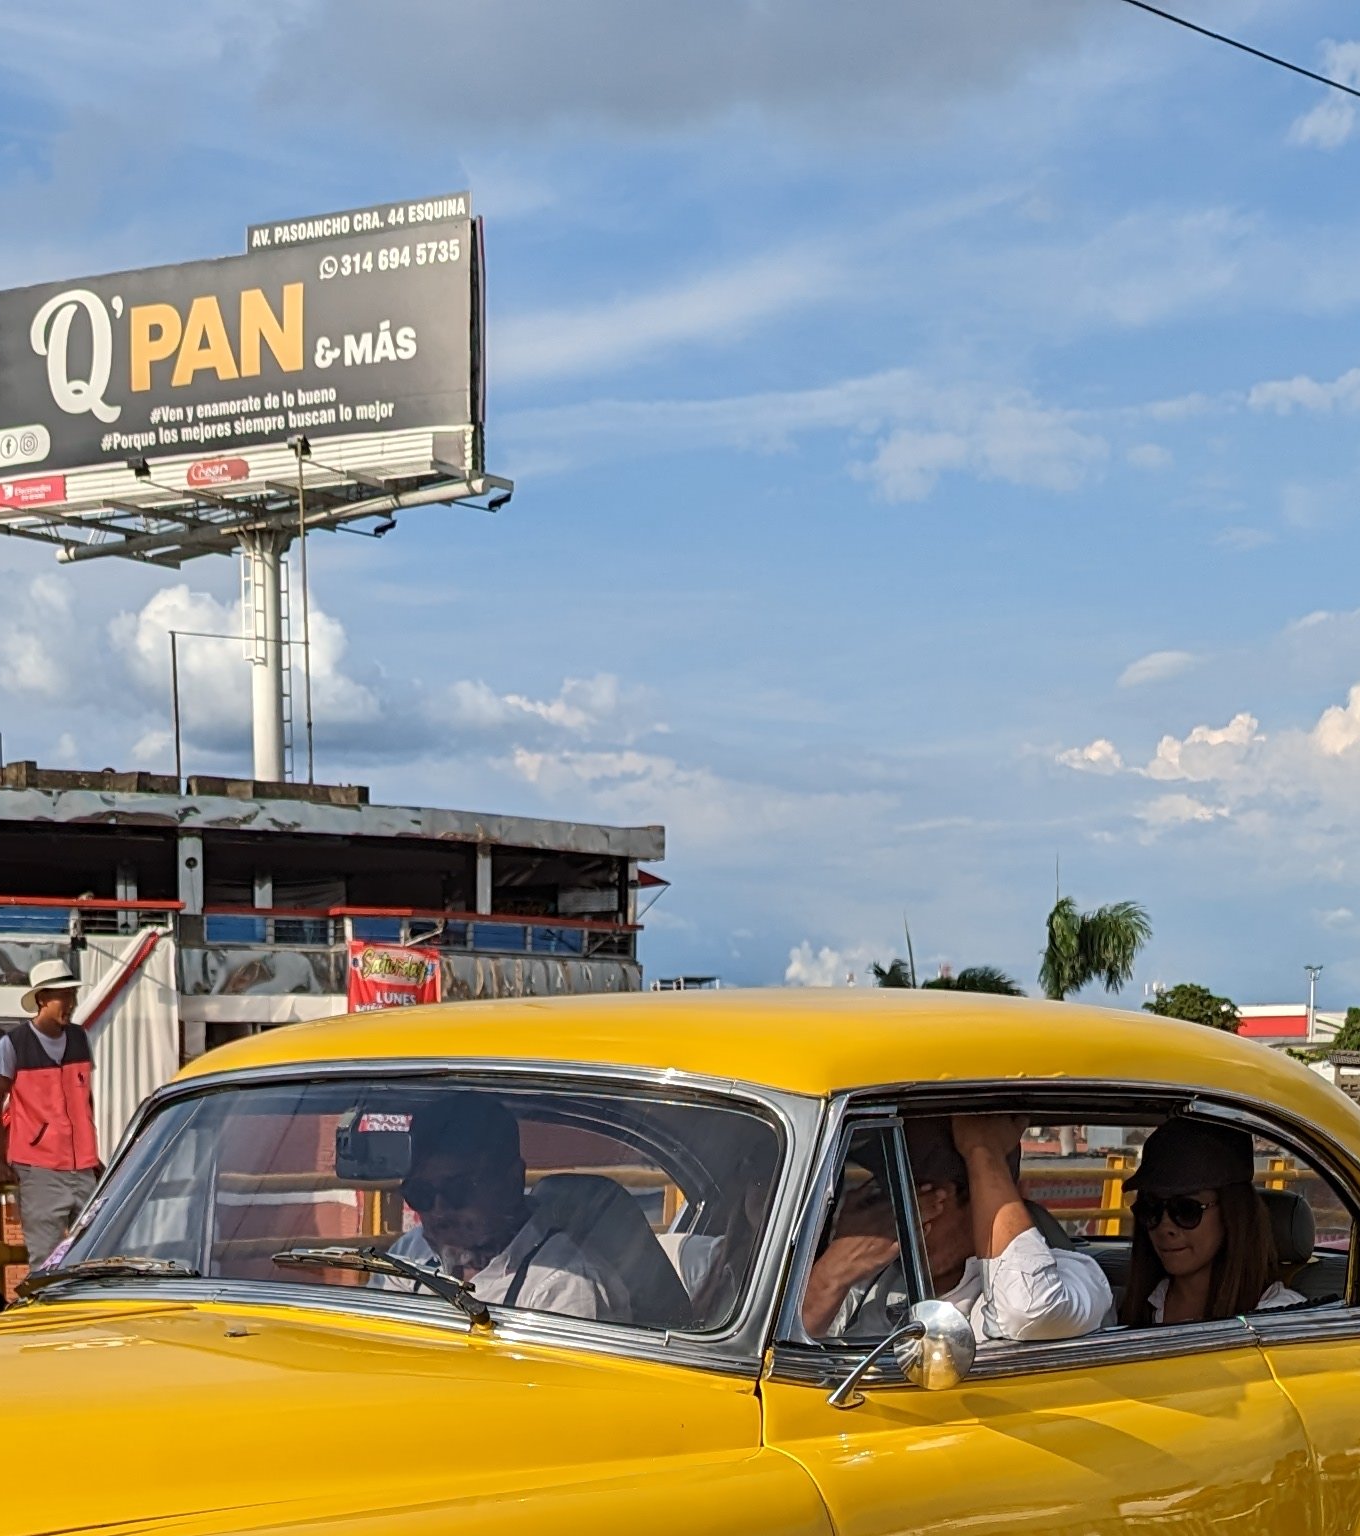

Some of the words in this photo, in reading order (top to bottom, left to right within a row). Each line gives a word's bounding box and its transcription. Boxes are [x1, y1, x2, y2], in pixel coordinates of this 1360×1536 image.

[252, 228, 271, 248] AV.
[274, 214, 350, 244] PASOANCHO
[353, 211, 384, 232] CRA.
[388, 208, 405, 226] 44
[408, 197, 466, 222] ESQUINA
[340, 251, 373, 277] 314
[378, 246, 411, 271] 694
[416, 239, 460, 266] 5735
[314, 336, 340, 369] &
[343, 320, 417, 367] MÁS
[101, 431, 156, 452] #Porque
[159, 426, 179, 444] los
[181, 421, 232, 444] mejores
[234, 415, 285, 435] siempre
[288, 408, 336, 429] buscan
[339, 404, 352, 422] lo
[355, 400, 395, 423] mejor
[150, 405, 183, 425] #Ven
[186, 405, 194, 423] y
[196, 396, 261, 419] enamorate
[264, 392, 280, 410] de
[282, 390, 295, 408] lo
[297, 387, 337, 406] bueno
[376, 991, 416, 1007] LUNES
